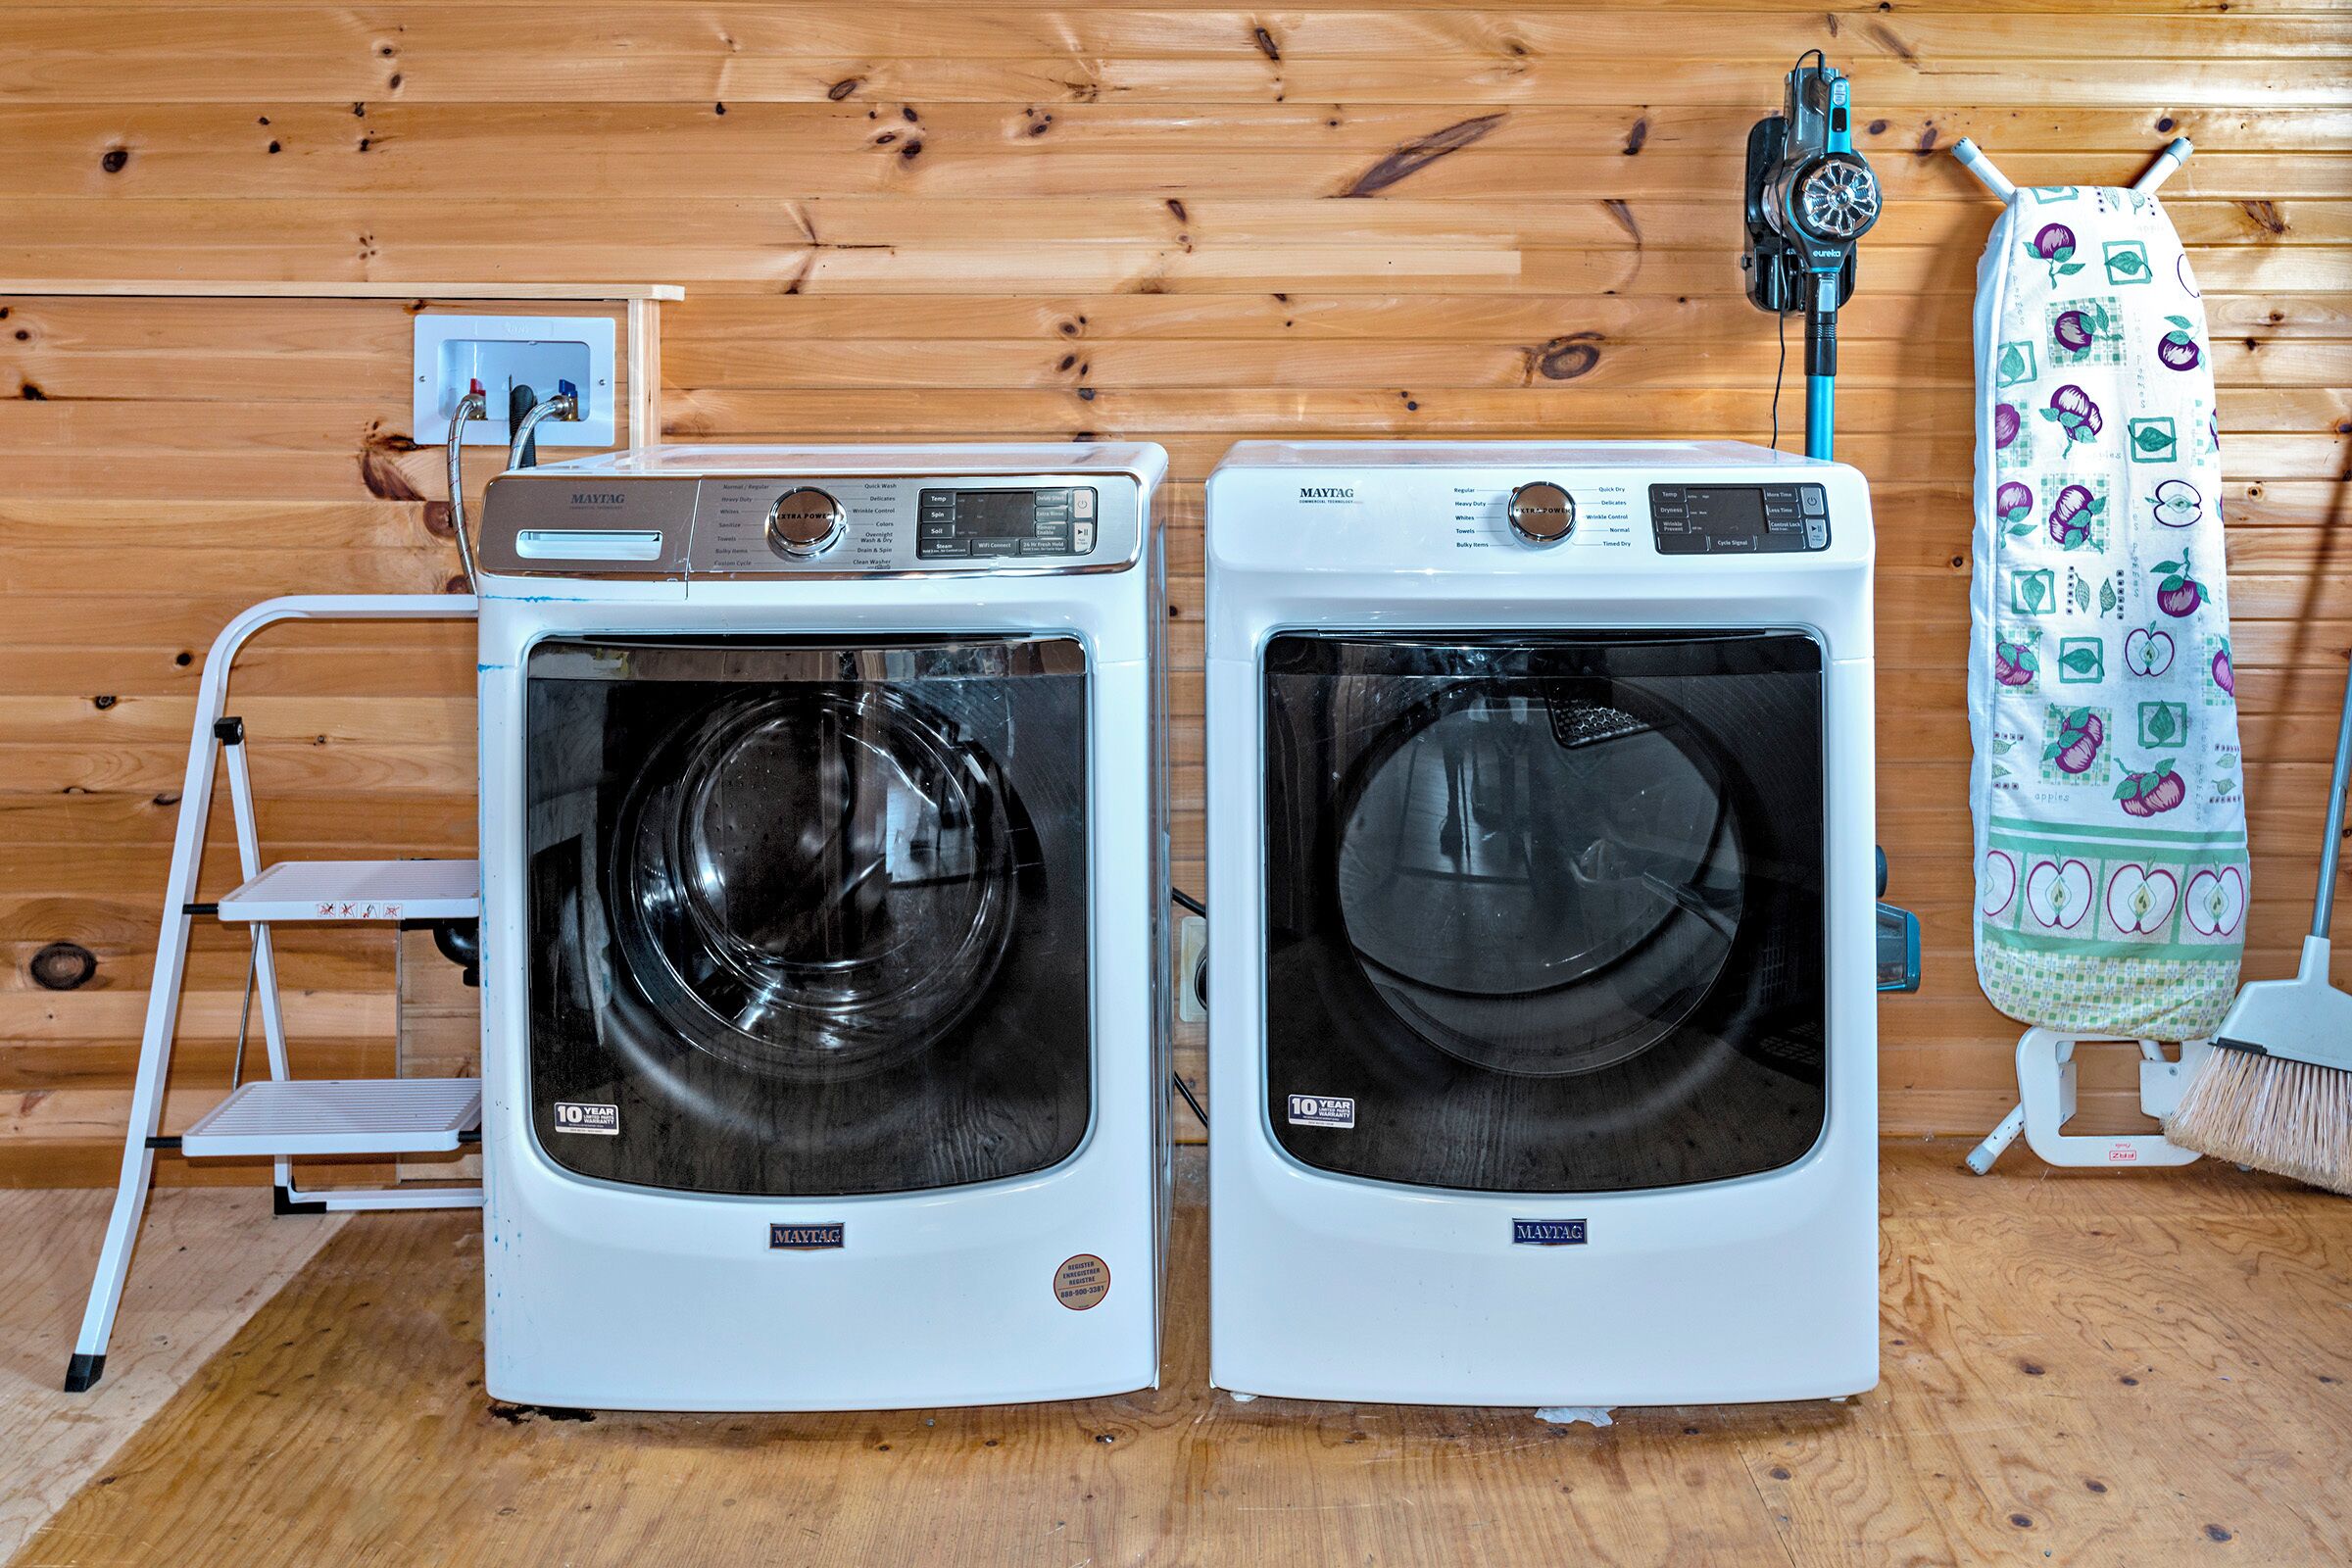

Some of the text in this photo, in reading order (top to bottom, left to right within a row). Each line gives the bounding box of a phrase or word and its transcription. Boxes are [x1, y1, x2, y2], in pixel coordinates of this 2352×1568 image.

[1813, 248, 1841, 258] eureka
[1299, 487, 1354, 498] MAYTAG
[570, 494, 625, 504] MAYTAG
[2034, 792, 2070, 804] apples
[1292, 1097, 1350, 1115] 10 YEAR
[558, 1105, 614, 1123] 10 YEAR
[774, 1229, 840, 1244] MAYTAG
[1517, 1225, 1583, 1240] MAYTAG
[1067, 1260, 1095, 1271] REGISTER
[1062, 1267, 1101, 1279] ENREGISTRER
